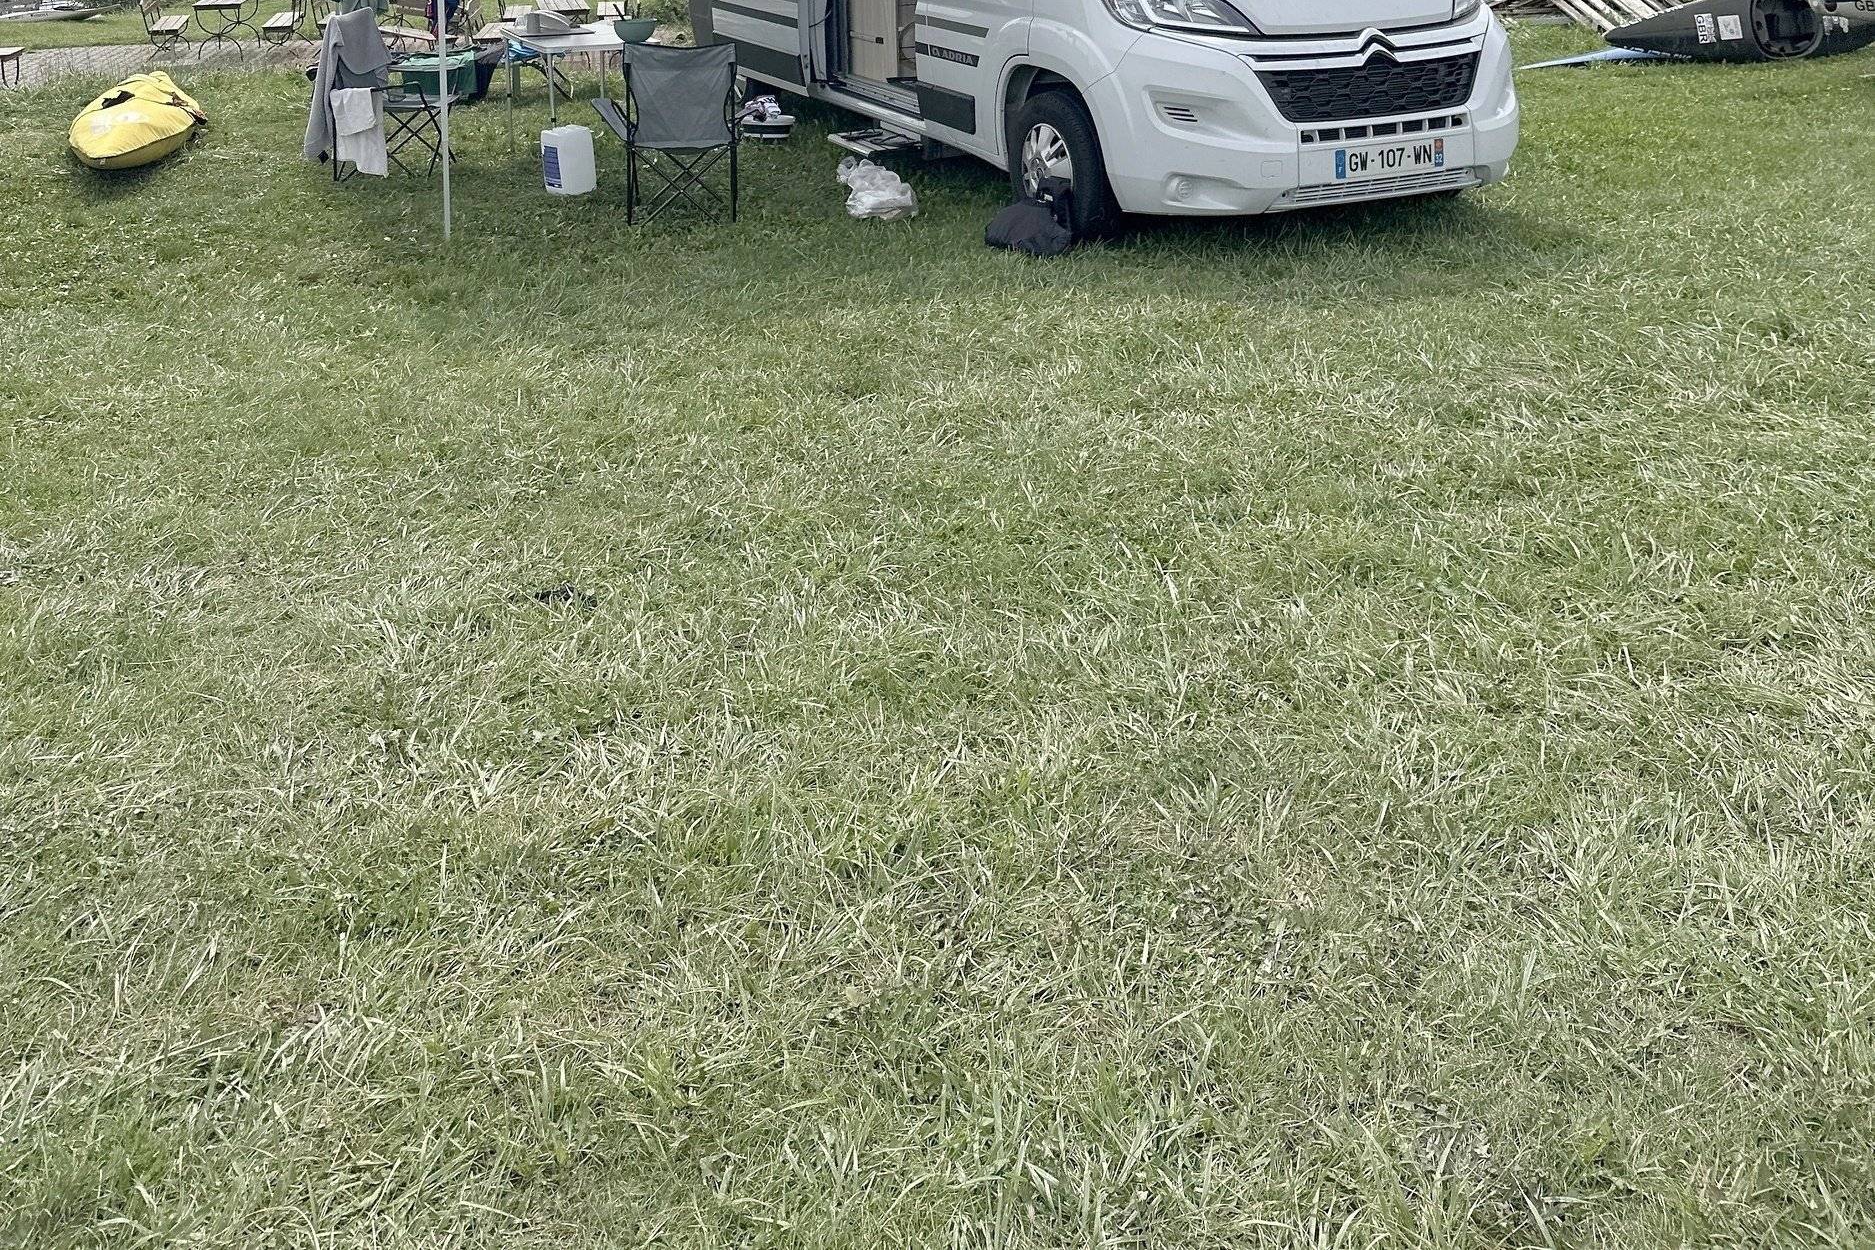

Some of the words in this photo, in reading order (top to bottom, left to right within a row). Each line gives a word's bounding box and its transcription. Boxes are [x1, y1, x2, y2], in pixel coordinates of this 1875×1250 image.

[1696, 15, 1708, 42] GBR
[942, 50, 974, 66] ADRIA
[1349, 144, 1432, 172] GW-107-WN
